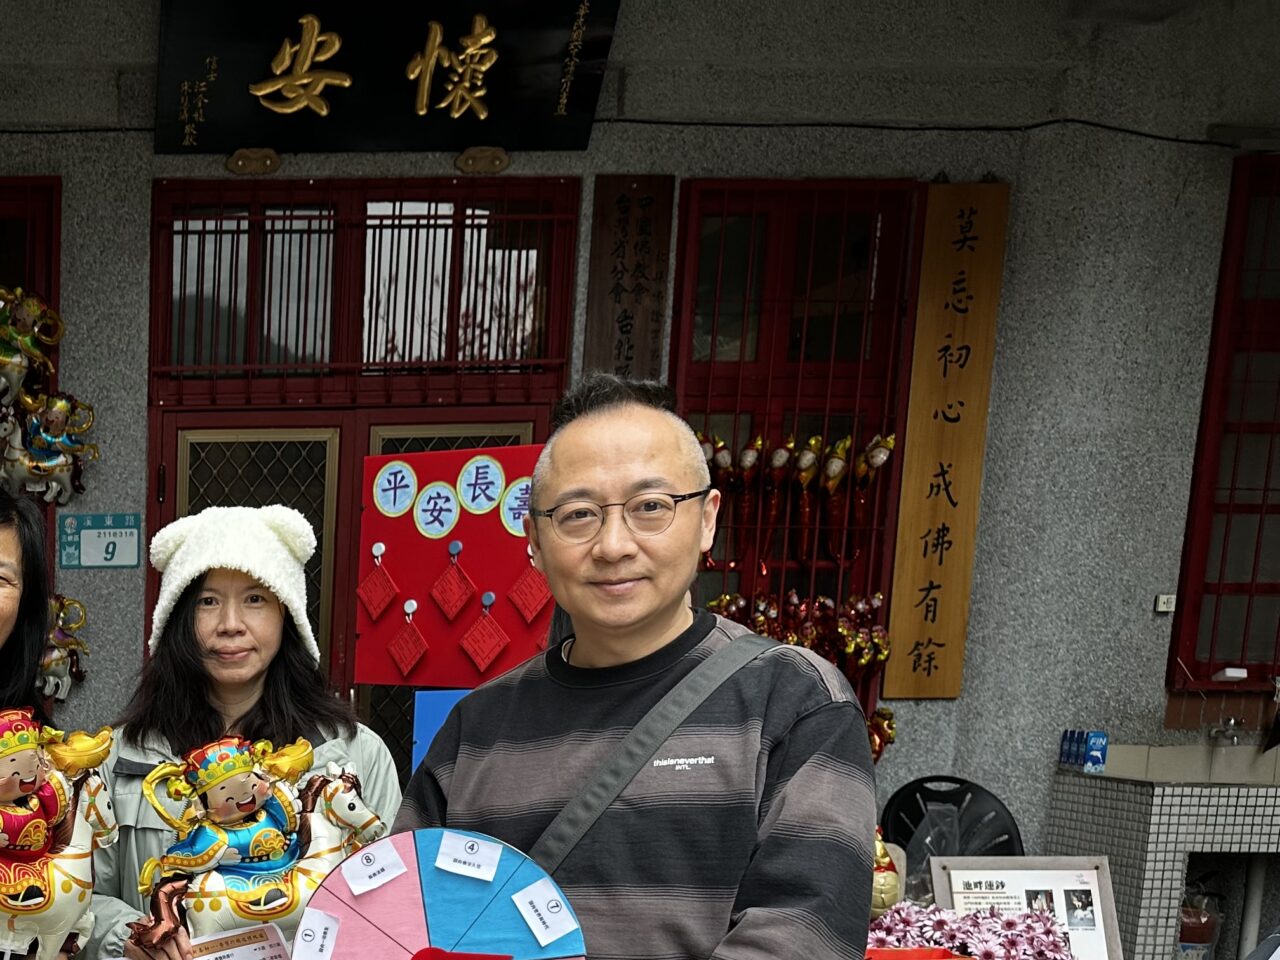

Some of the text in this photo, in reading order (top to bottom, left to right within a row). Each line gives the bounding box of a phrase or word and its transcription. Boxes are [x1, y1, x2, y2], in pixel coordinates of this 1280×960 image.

[248, 14, 499, 119] 懷安
[907, 207, 979, 678] 莫忘初心成佛有餘
[104, 541, 117, 561] 9
[653, 756, 715, 767] thisisneverthat
